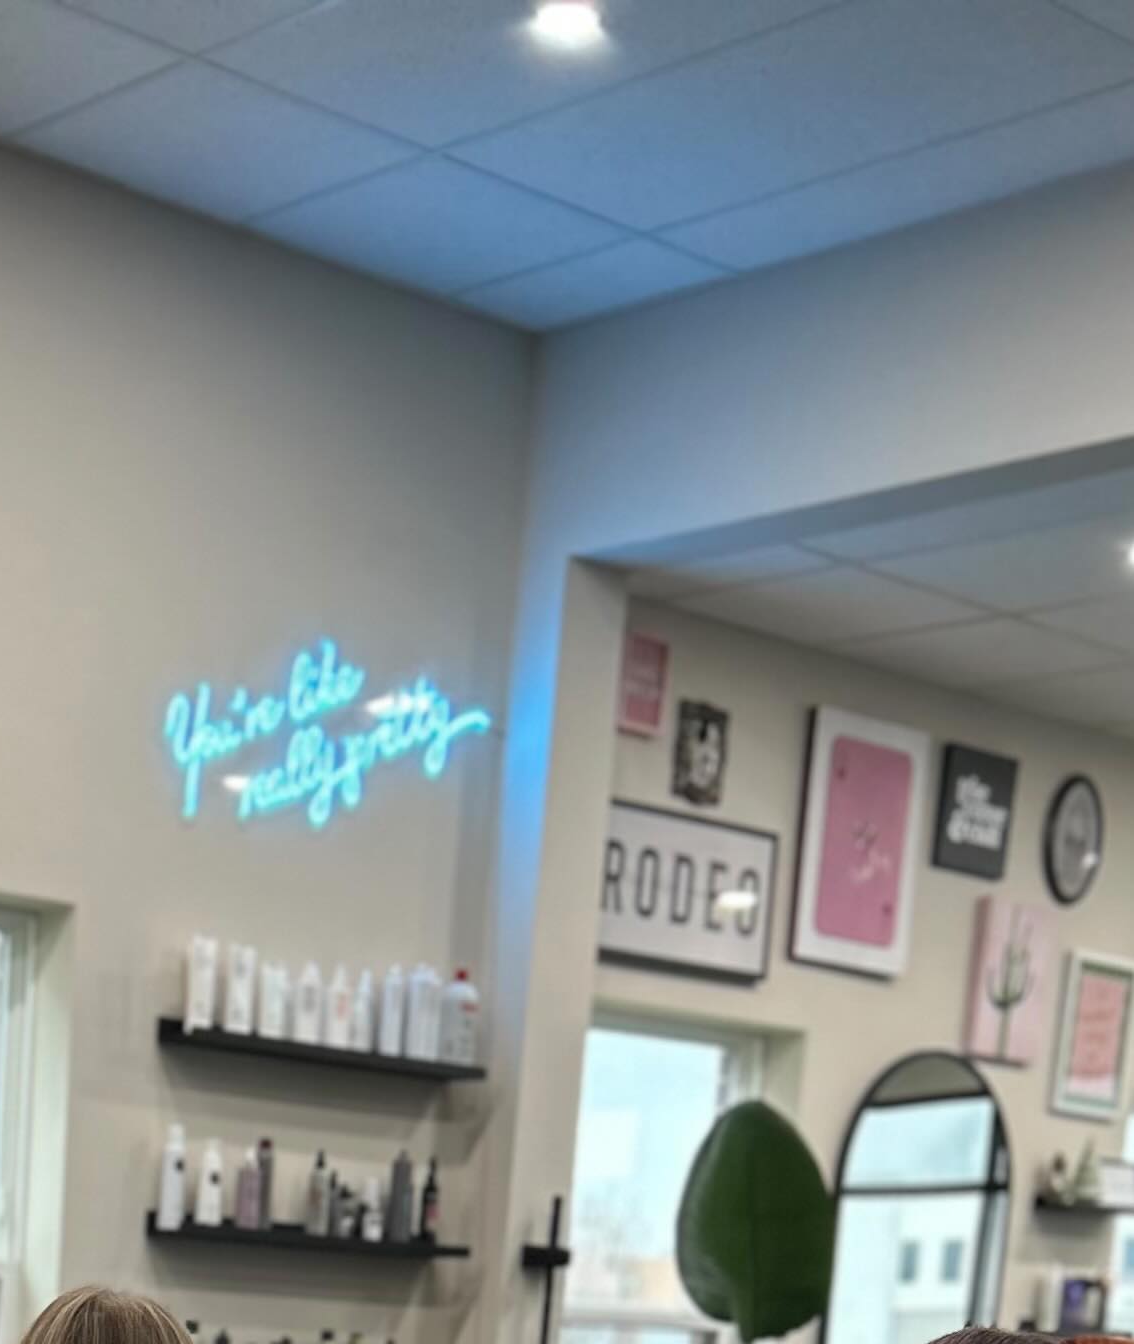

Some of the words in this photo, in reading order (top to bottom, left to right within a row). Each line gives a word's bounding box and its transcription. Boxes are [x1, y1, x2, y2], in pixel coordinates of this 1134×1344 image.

[287, 635, 366, 722] like
[236, 726, 337, 829] really
[339, 675, 493, 808] pretty
[601, 837, 761, 938] RODEO
